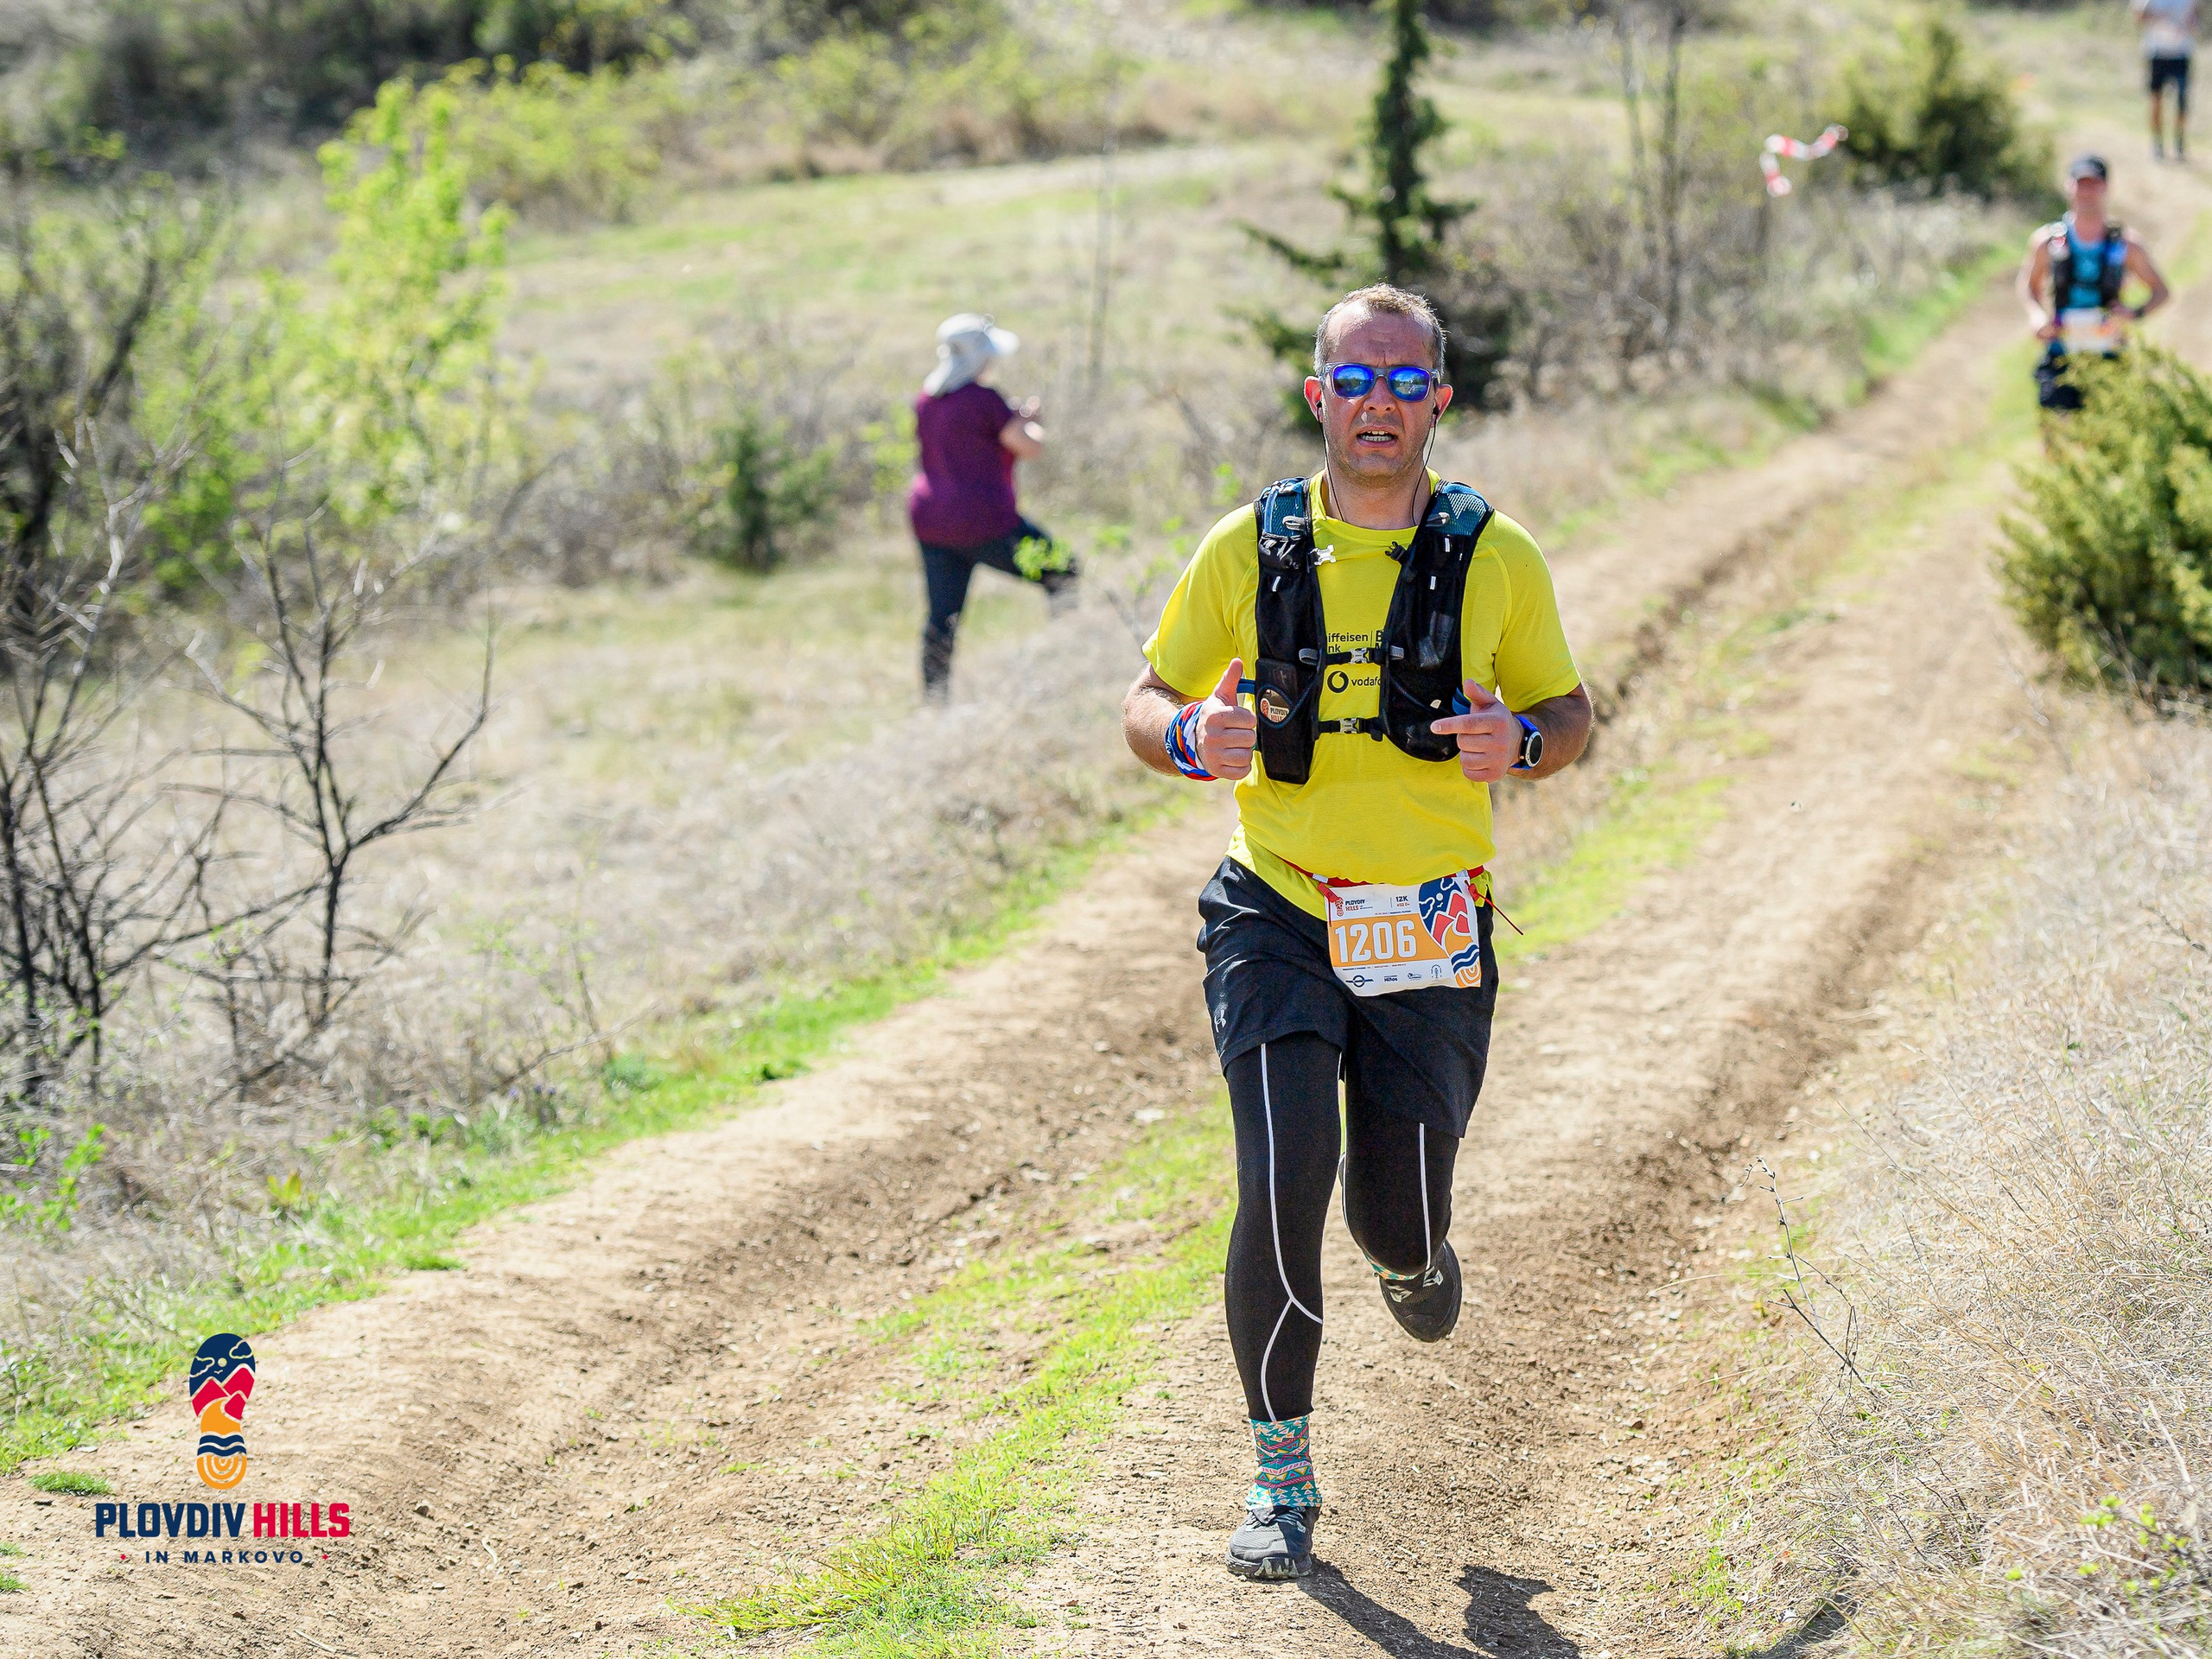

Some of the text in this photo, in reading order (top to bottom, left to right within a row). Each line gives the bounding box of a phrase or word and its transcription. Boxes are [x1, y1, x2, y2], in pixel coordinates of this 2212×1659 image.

[1328, 632, 1369, 642] iffeisen
[1328, 644, 1341, 653] nk
[1351, 677, 1381, 686] vodafo
[1335, 920, 1417, 963] 1206
